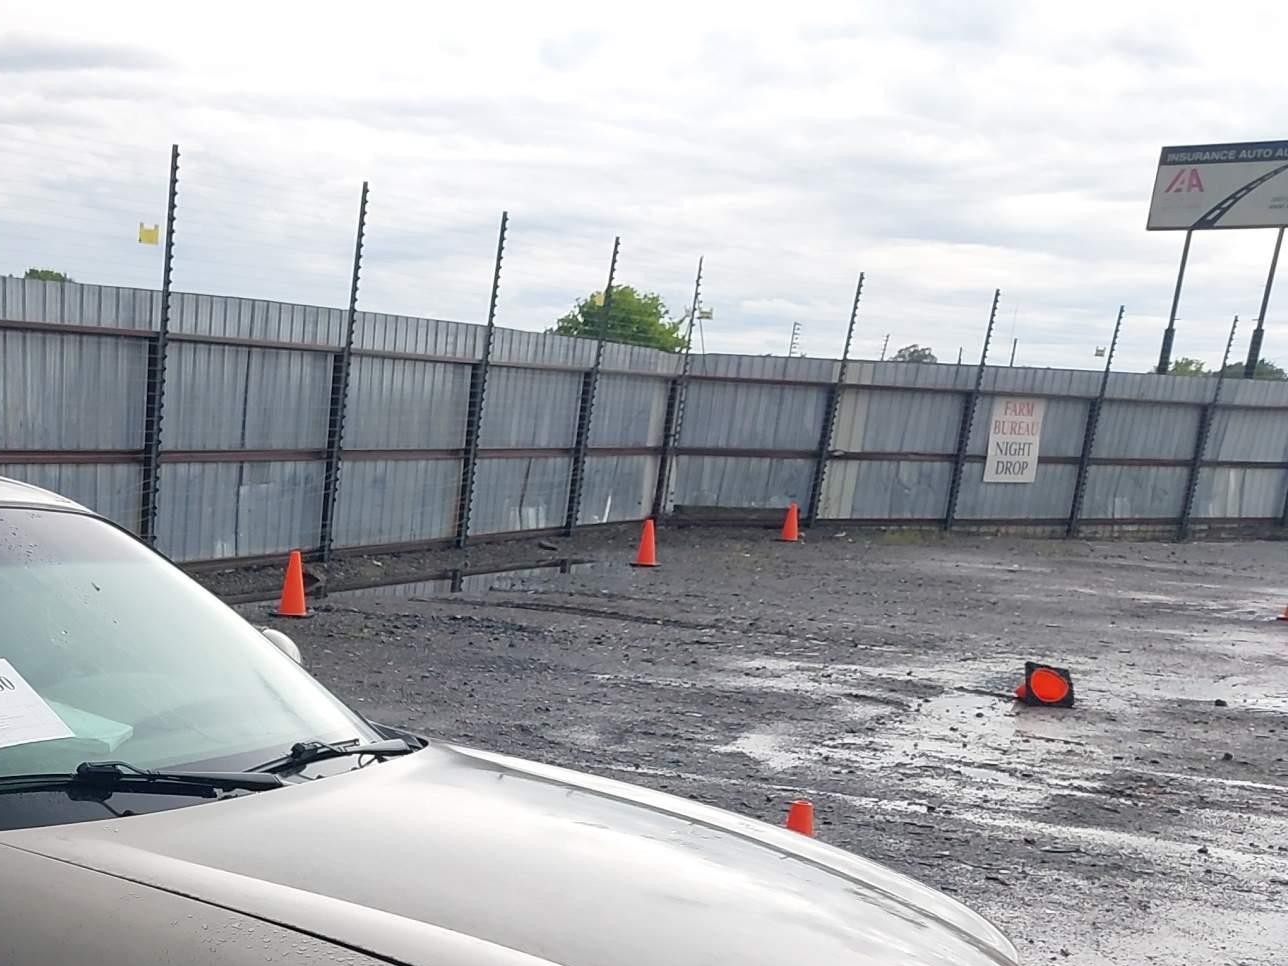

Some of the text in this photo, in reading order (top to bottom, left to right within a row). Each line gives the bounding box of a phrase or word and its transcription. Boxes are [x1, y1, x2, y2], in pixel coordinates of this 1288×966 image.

[1167, 149, 1238, 163] INSURANCE
[1239, 147, 1273, 160] AUTO
[1003, 400, 1036, 417] FARM
[993, 420, 1039, 436] BUREAU
[995, 441, 1033, 457] NIGHT
[995, 460, 1029, 475] DROP
